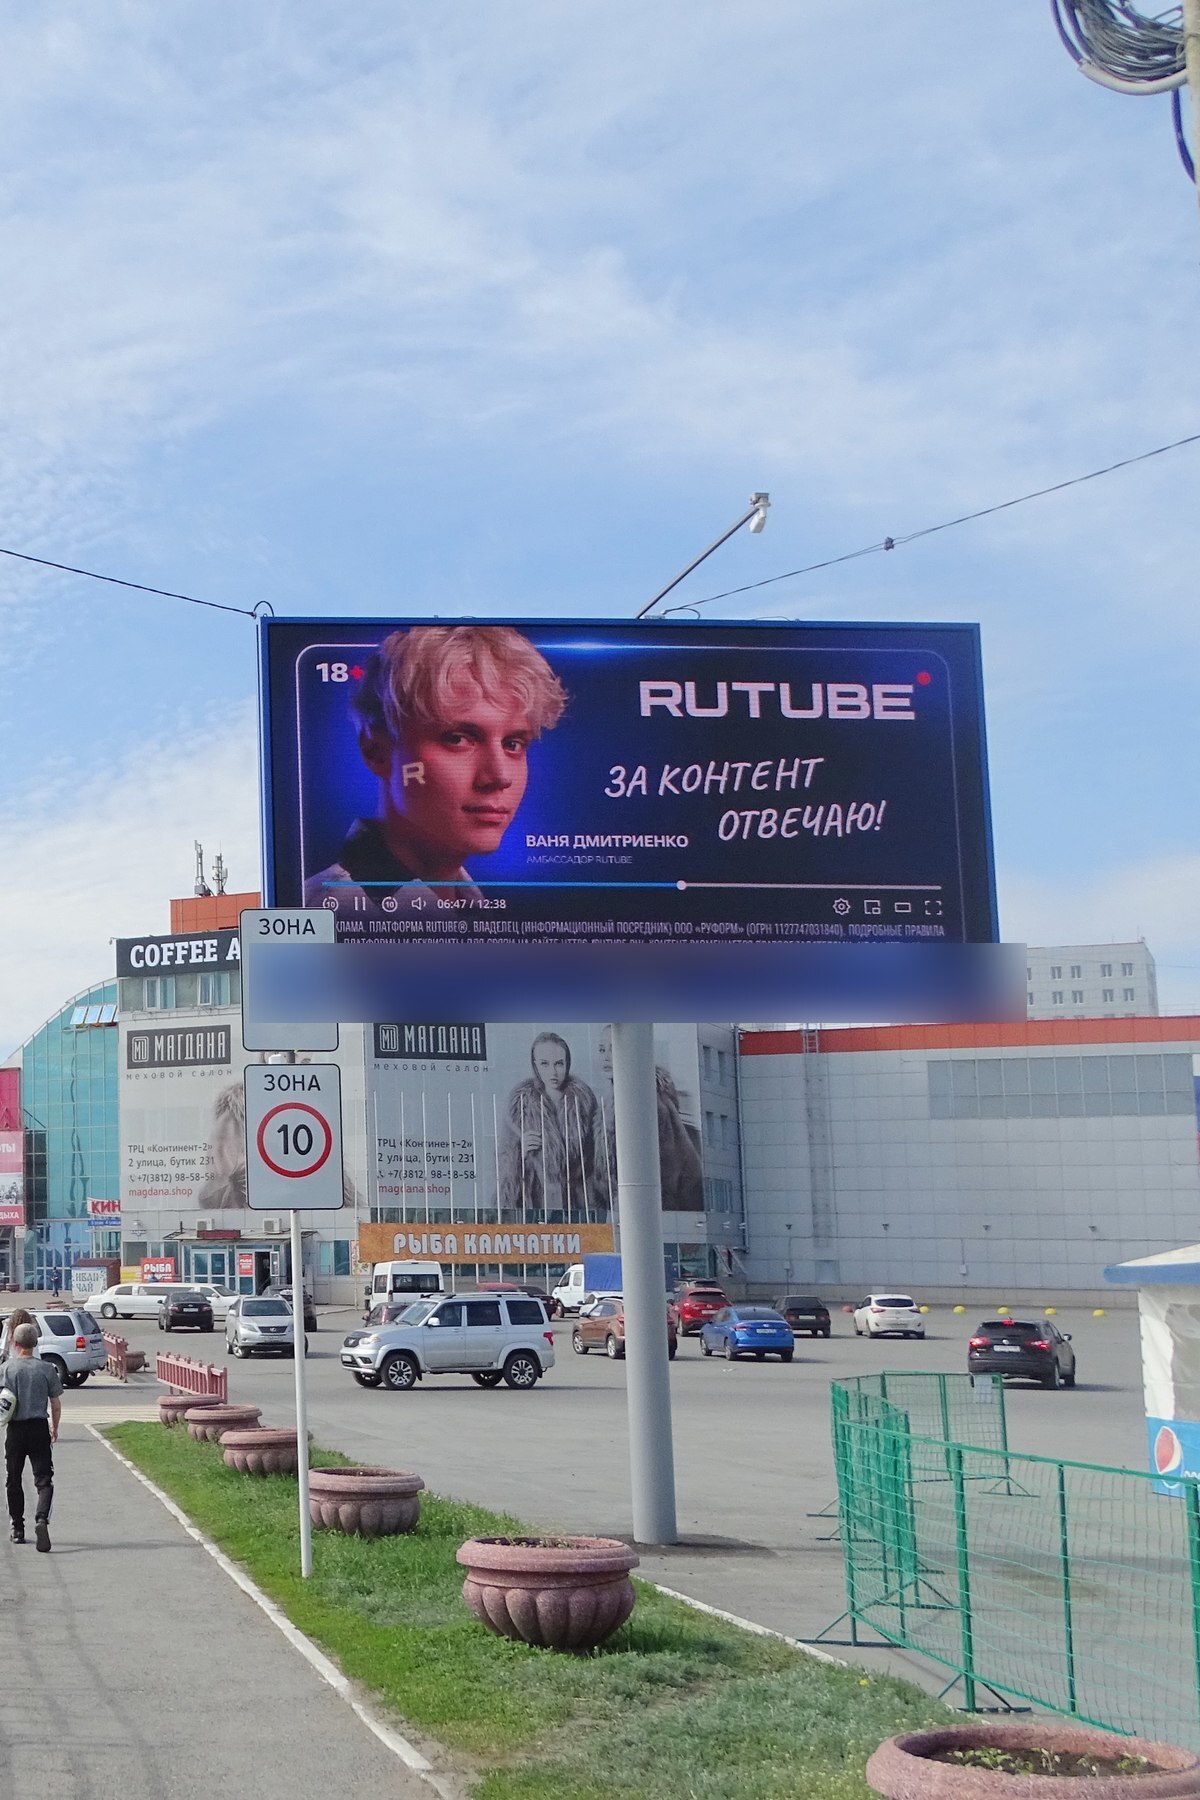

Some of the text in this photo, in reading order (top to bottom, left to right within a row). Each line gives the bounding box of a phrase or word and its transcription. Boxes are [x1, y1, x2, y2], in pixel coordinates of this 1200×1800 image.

[315, 662, 365, 682] 18+
[639, 680, 915, 720] RUTUBE
[402, 761, 426, 787] R
[604, 757, 825, 798] ЗА КОНТЕНТ
[718, 800, 886, 841] ОТВЕЧАЮ!
[526, 835, 689, 849] ВАНЯ ДМИТРИЕНКО
[526, 855, 633, 865] АМБАССАДОР RUTUBE
[437, 898, 467, 909] 06:47
[477, 898, 507, 909] 12:38
[259, 918, 316, 935] ЗОНА
[369, 920, 424, 933] ПЛАТФОРМА
[473, 921, 520, 935] ВЛАДЕЛЕЦ
[521, 920, 615, 935] (ИНФОРМАЦИОННЫЙ
[617, 921, 673, 936] ПОСРЕДНИК)
[674, 922, 693, 934] ООО
[695, 922, 744, 935] «РУФОРМ»
[746, 922, 773, 936] (ОГРН
[848, 924, 903, 937] ПОДРОБНЫЕ
[904, 924, 945, 937] ПРАВИЛА
[130, 939, 218, 968] COFFEE
[154, 1031, 226, 1061] МАГДАНА
[404, 1025, 481, 1054] МАГДАНА
[126, 1069, 232, 1080] меховой салон
[373, 1062, 489, 1072] меховой салон
[263, 1074, 321, 1092] ЗОНА
[276, 1123, 313, 1156] 10
[377, 1138, 397, 1149] ТРЦ
[128, 1143, 213, 1155] ТРЦ «Континент-2»
[128, 1156, 215, 1169] 2 улица, бутик 231
[377, 1153, 383, 1162] 2
[458, 1153, 475, 1163] 231
[137, 1172, 215, 1184] +7(3812) 98-58-58
[128, 1187, 193, 1199] magdana.shop
[393, 1232, 582, 1256] РЫБА КАМЧАТКИ
[143, 1263, 172, 1273] РЫБА
[76, 1282, 94, 1292] ЧАЙ
